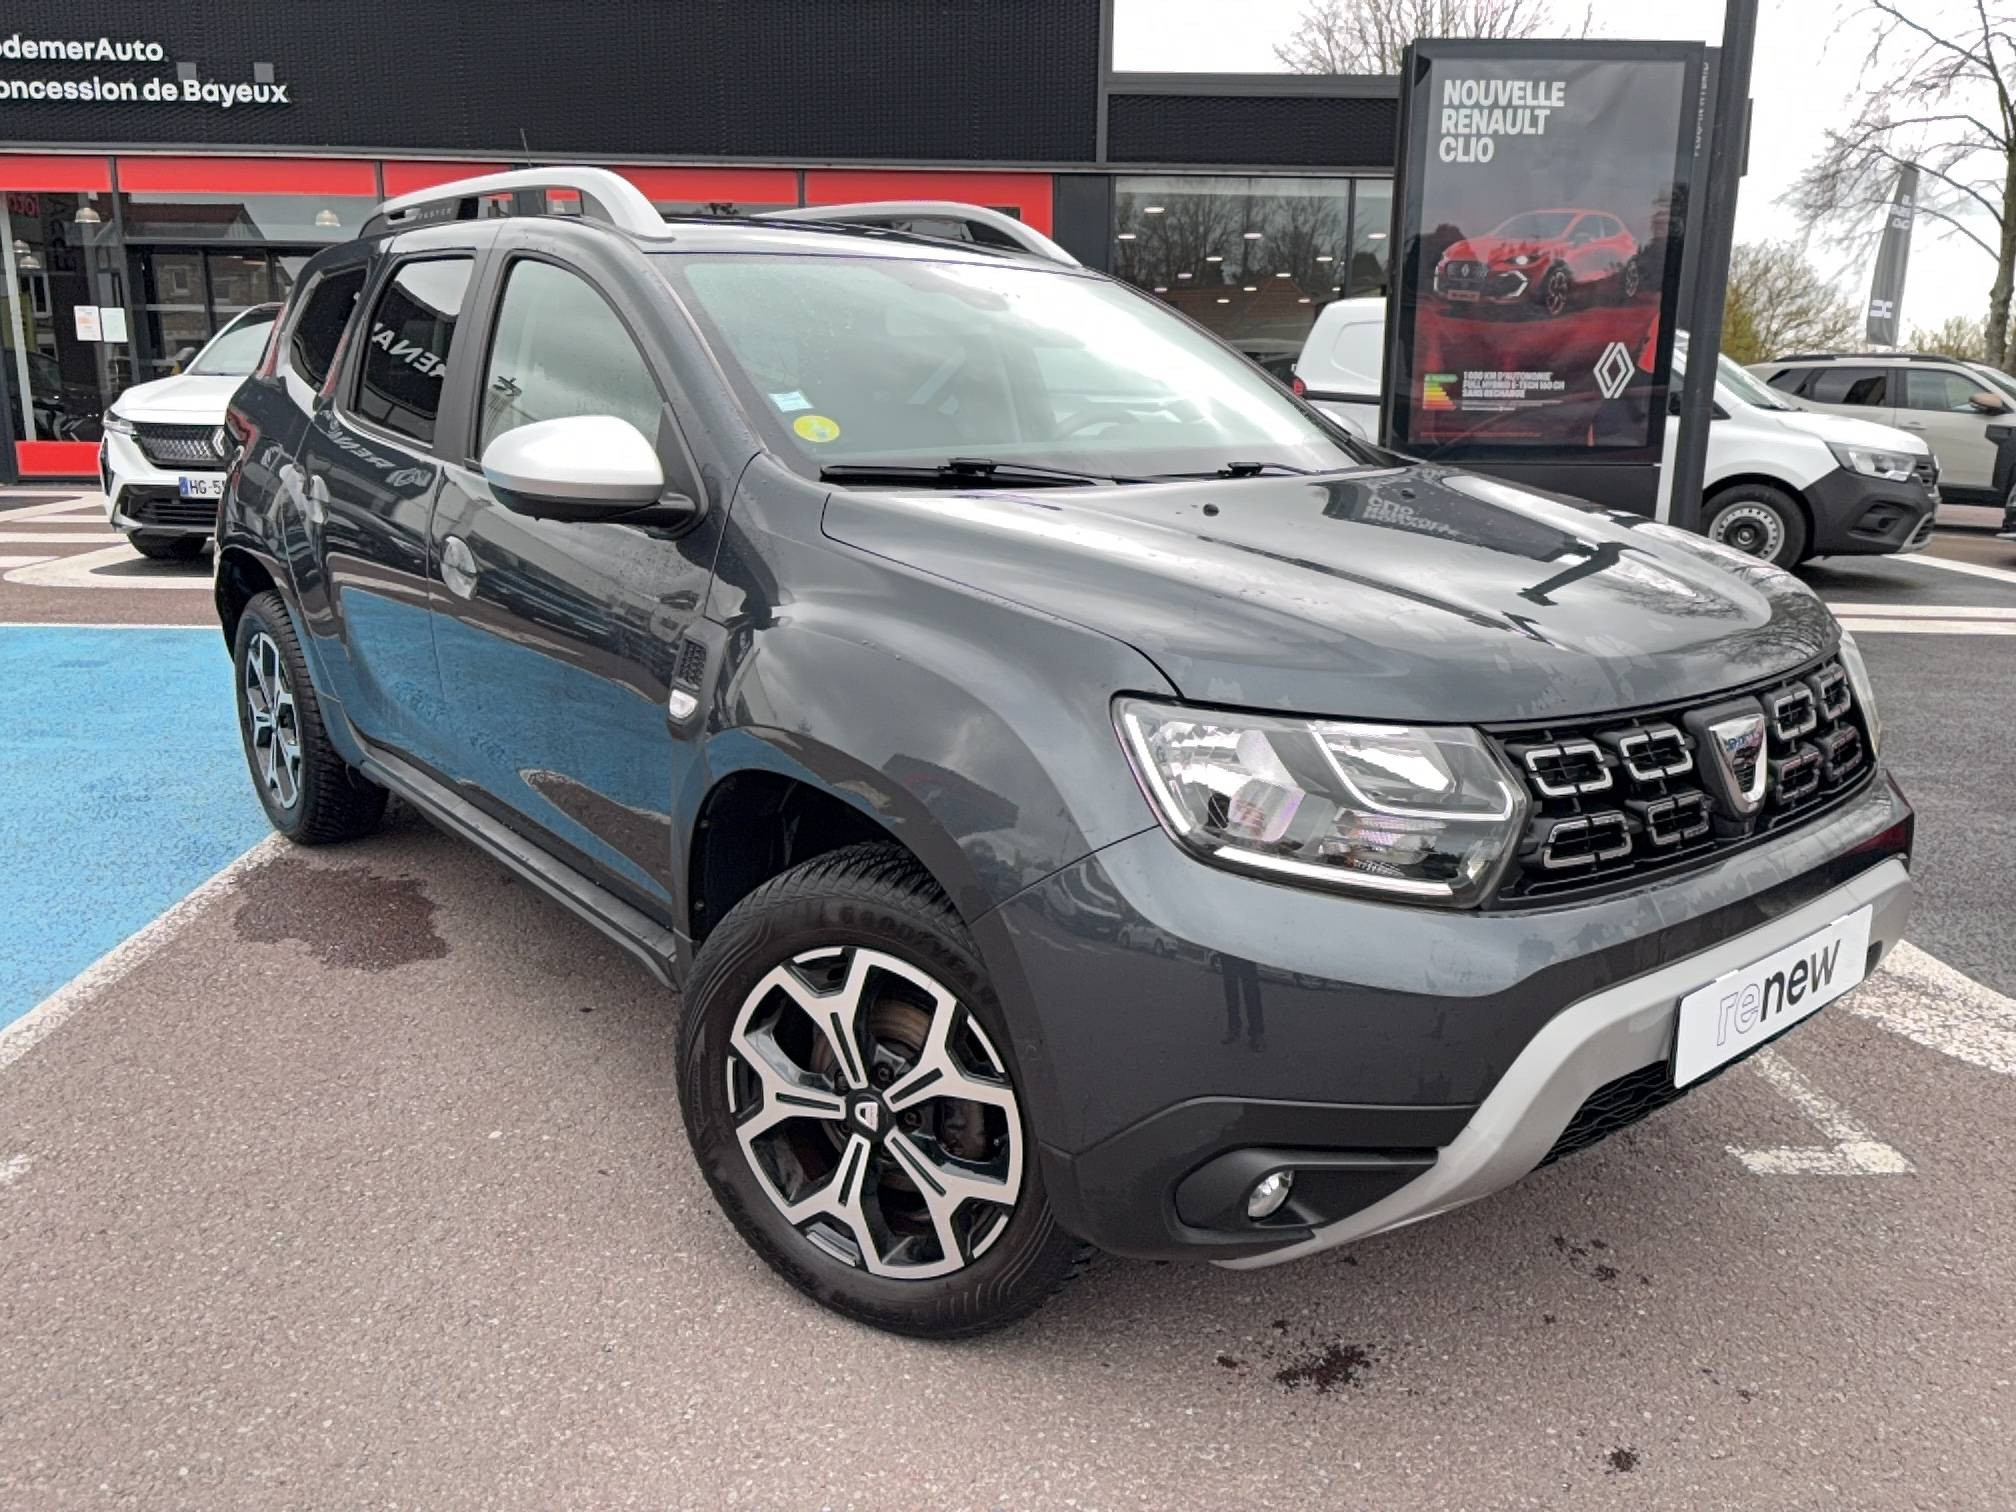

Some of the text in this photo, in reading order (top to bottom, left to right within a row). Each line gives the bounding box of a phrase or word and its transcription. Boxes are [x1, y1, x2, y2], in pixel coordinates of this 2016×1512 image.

[0, 34, 164, 61] demerAuto
[142, 77, 179, 101] de
[183, 79, 289, 108] Bayeux
[1443, 79, 1567, 107] NOUVELLE
[1441, 107, 1551, 135] RENAULT
[1439, 136, 1495, 163] CLIO
[1716, 938, 1841, 1047] renew
